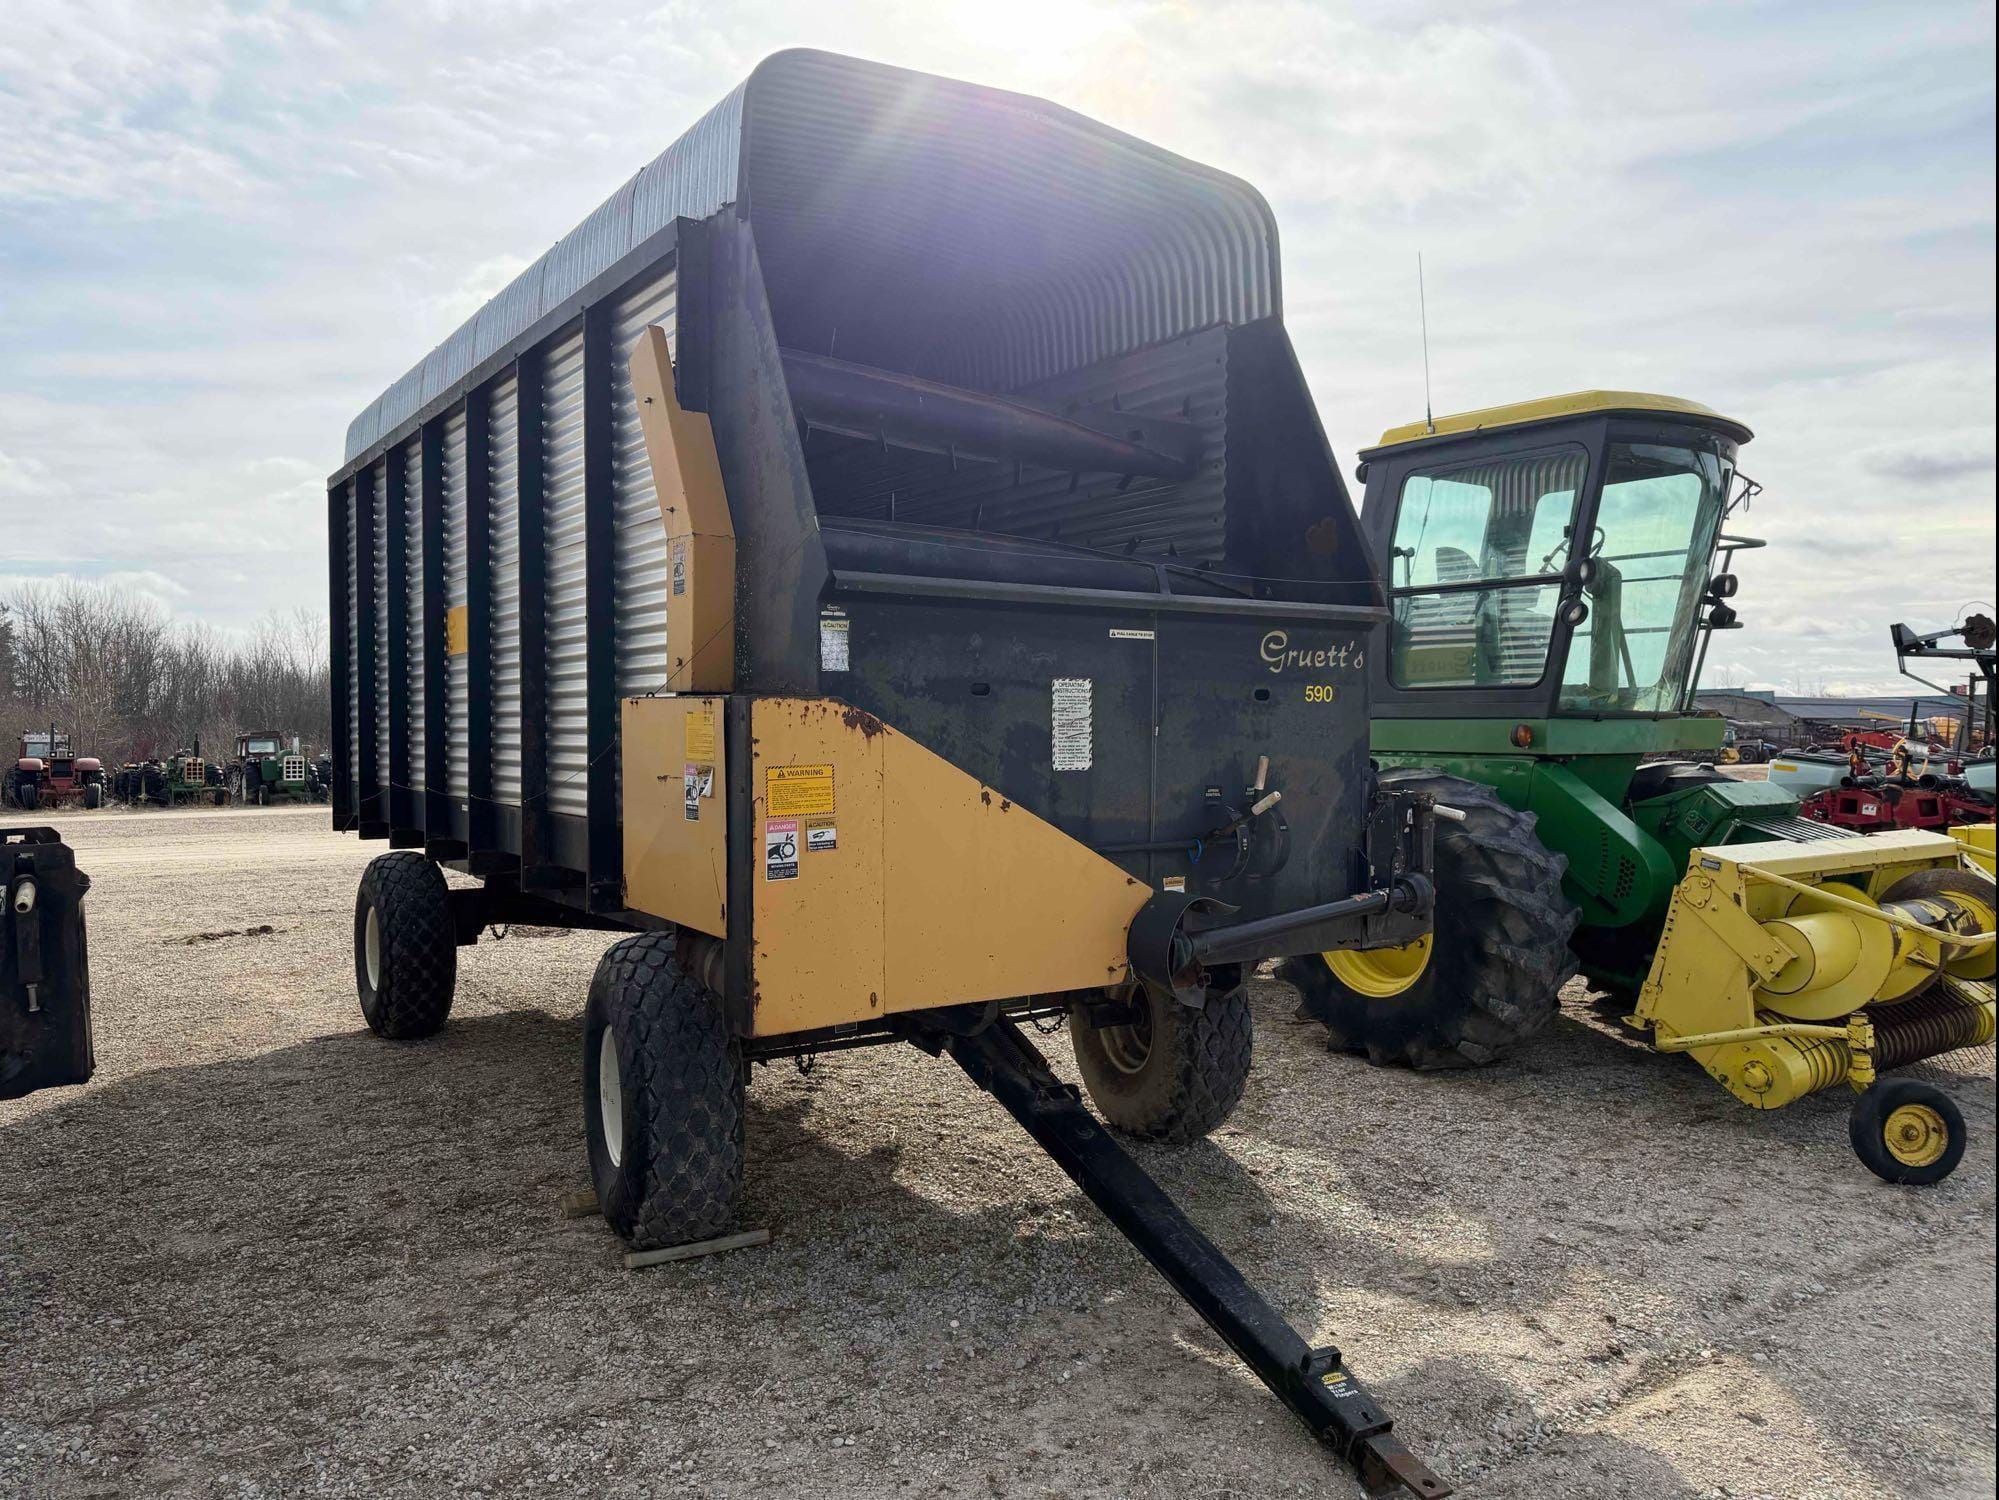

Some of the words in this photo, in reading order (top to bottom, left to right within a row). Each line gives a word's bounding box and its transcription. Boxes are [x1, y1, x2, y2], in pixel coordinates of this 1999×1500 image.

[1260, 630, 1364, 673] Gruett's
[1304, 685, 1333, 703] 590
[786, 769, 824, 777] WARNING
[774, 823, 796, 831] DANGER
[813, 820, 835, 828] CAUTION
